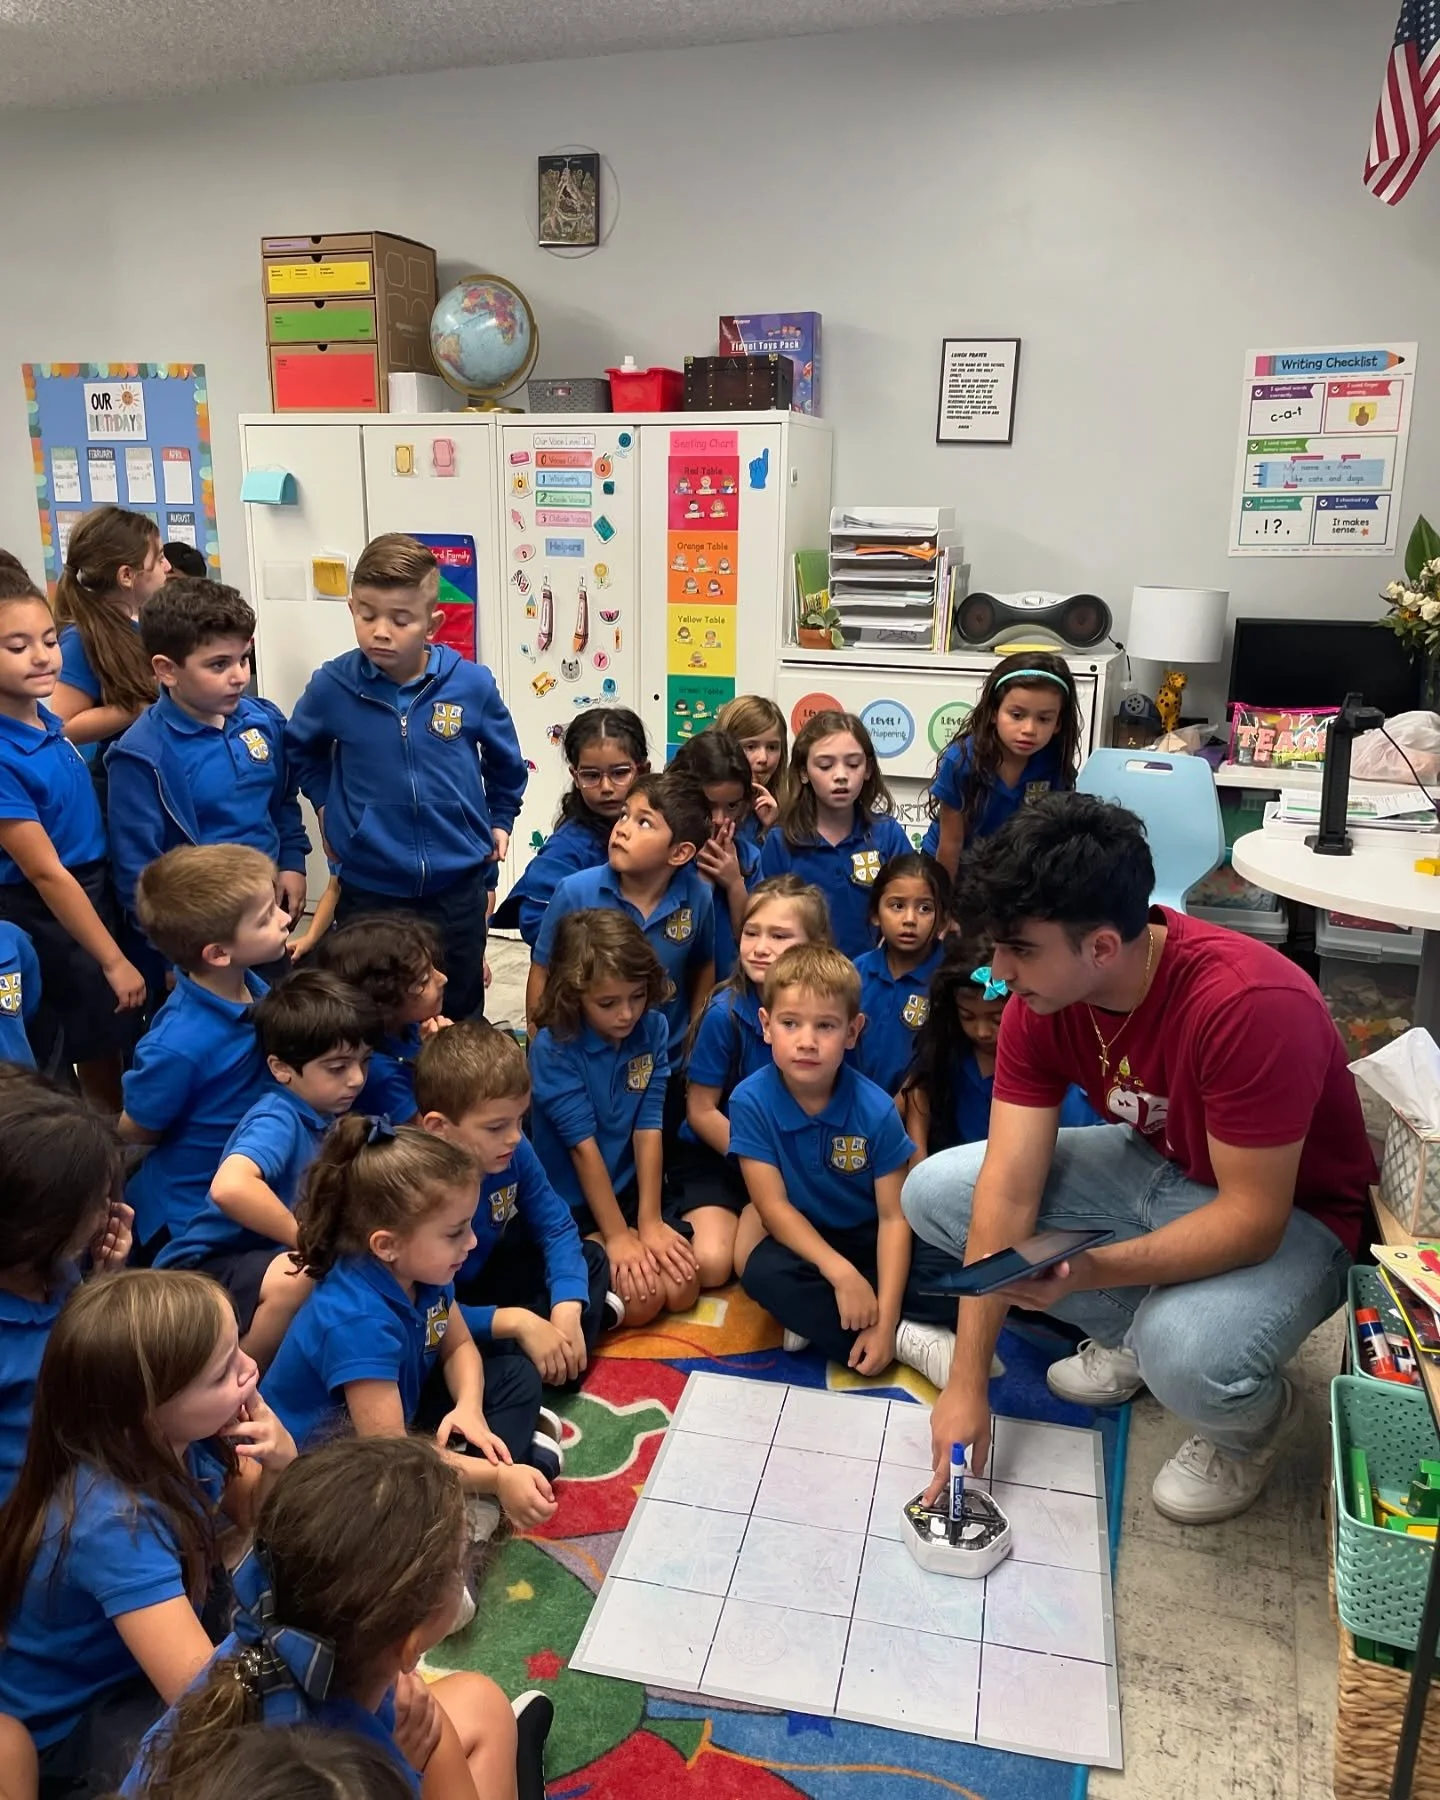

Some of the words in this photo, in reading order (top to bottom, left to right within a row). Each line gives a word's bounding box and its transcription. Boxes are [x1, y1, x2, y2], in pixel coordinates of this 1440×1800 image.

[759, 341, 777, 350] Toys
[780, 340, 799, 349] Pack
[1281, 358, 1323, 371] Writing
[1325, 355, 1378, 369] Checklist
[91, 392, 112, 410] OUR
[1270, 406, 1302, 422] c-a-t
[89, 413, 142, 432] BIRTHDAYS
[535, 436, 547, 445] Our
[549, 437, 564, 446] Voice
[673, 438, 707, 451] Seating
[709, 438, 734, 449] Chart
[88, 449, 113, 459] FEBRUARY
[169, 449, 184, 460] APRIL
[702, 467, 723, 475] Table
[170, 513, 190, 524] AUGUST
[1332, 518, 1341, 526] It
[1343, 518, 1370, 526] makes
[549, 541, 582, 553] Helpers
[677, 542, 704, 552] Orange
[706, 542, 728, 551] Table
[446, 549, 470, 564] Family
[678, 616, 702, 624] Yellow
[704, 616, 725, 624] Table
[702, 686, 724, 695] Table
[870, 716, 895, 726] LEVEL
